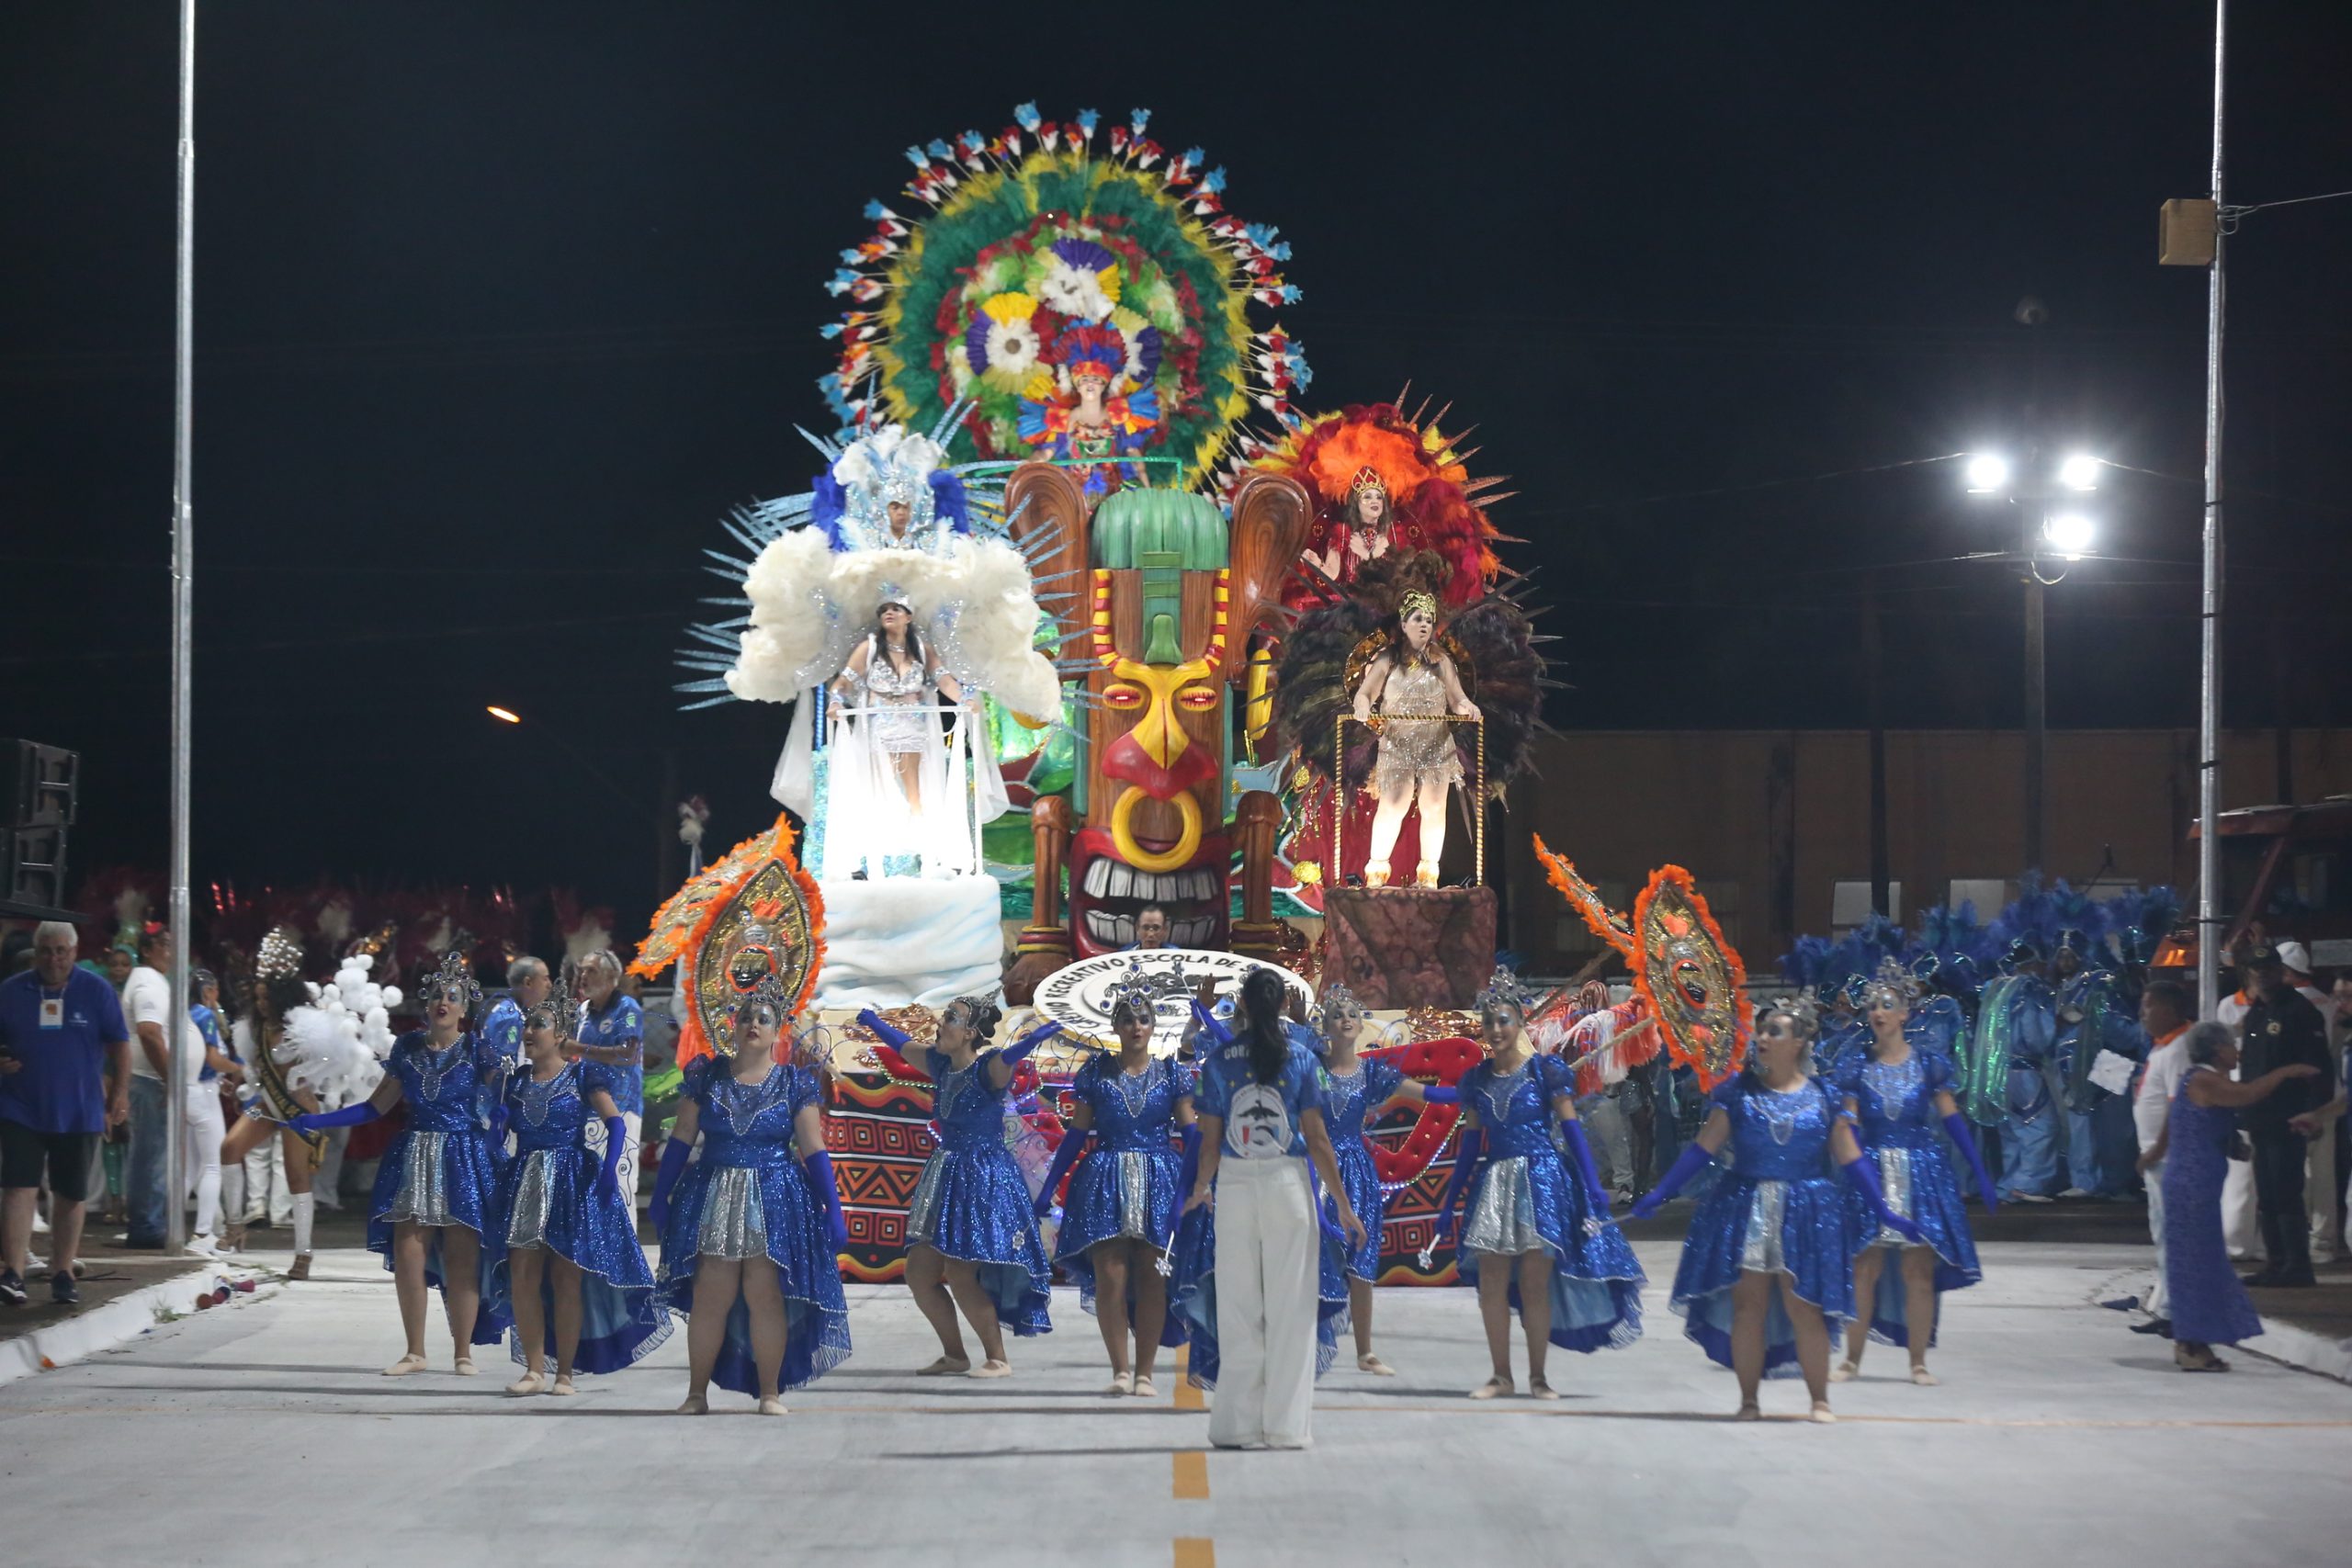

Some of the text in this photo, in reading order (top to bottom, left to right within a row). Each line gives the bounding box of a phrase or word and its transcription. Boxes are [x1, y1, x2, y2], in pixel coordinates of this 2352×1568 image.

[1045, 958, 1125, 998] RECREATIVO
[1129, 954, 1209, 964] ESCOLA
[1215, 958, 1242, 968] DE
